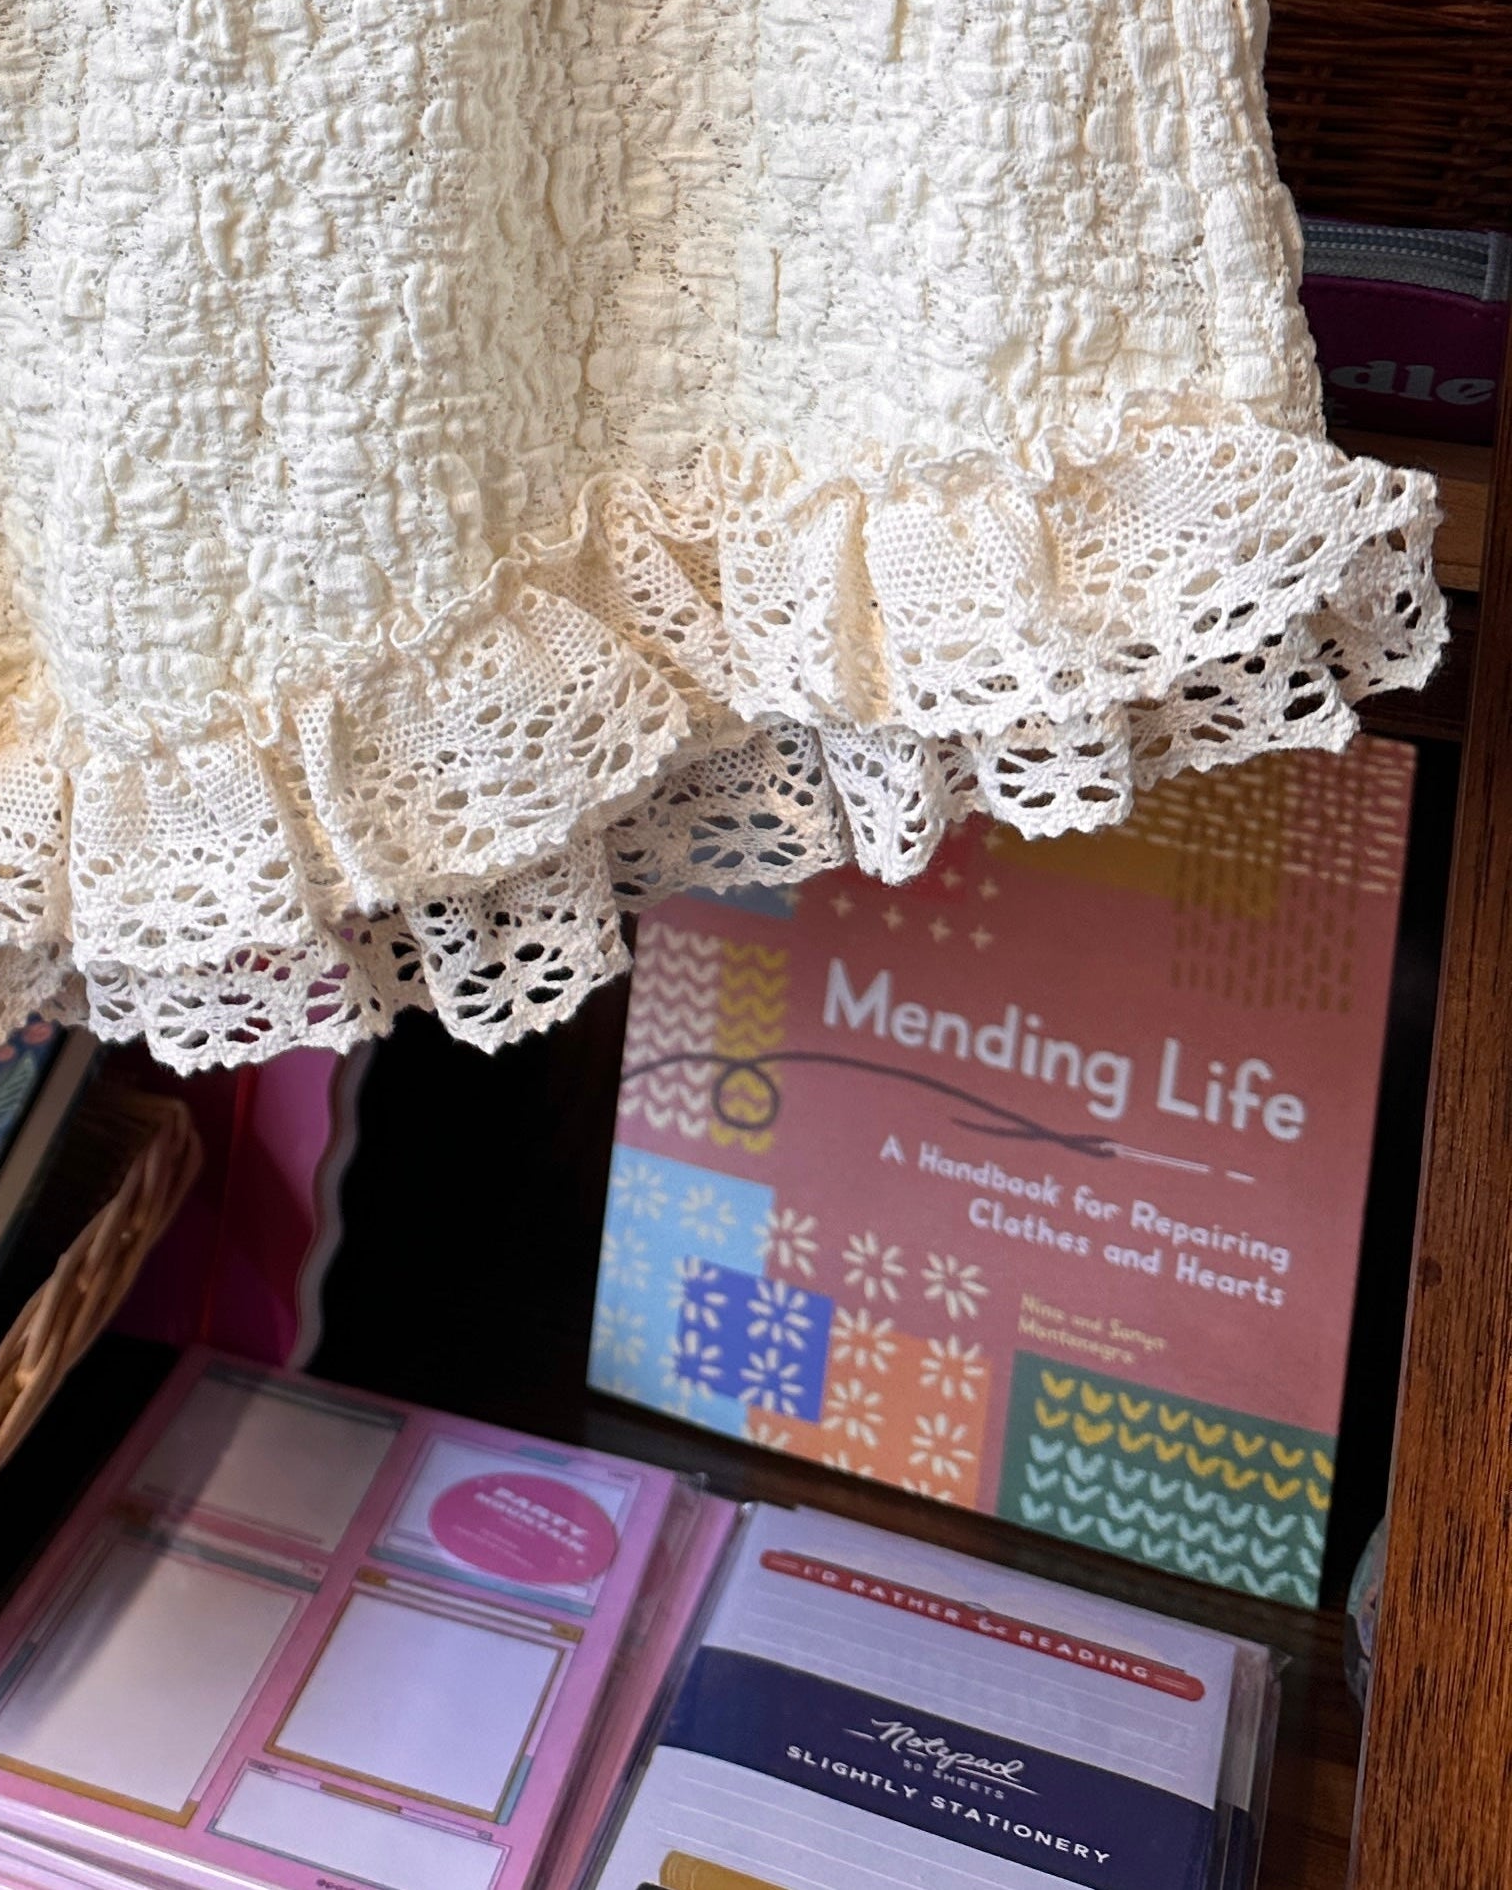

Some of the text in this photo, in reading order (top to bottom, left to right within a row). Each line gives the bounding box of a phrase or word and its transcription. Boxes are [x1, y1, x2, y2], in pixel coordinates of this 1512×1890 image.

[823, 956, 1306, 1141] Mending Life
[880, 1135, 1290, 1274] A Handbook for Repairing
[968, 1196, 1286, 1309] Clothes and Hearts
[802, 1564, 838, 1585] I'D
[849, 1577, 961, 1623] RATHER
[1018, 1629, 1150, 1680] READING
[785, 1744, 1111, 1865] SLIGHTLY STATIONERY
[870, 1717, 1025, 1783] Notepad
[902, 1758, 1006, 1801] 50 SHEETS
